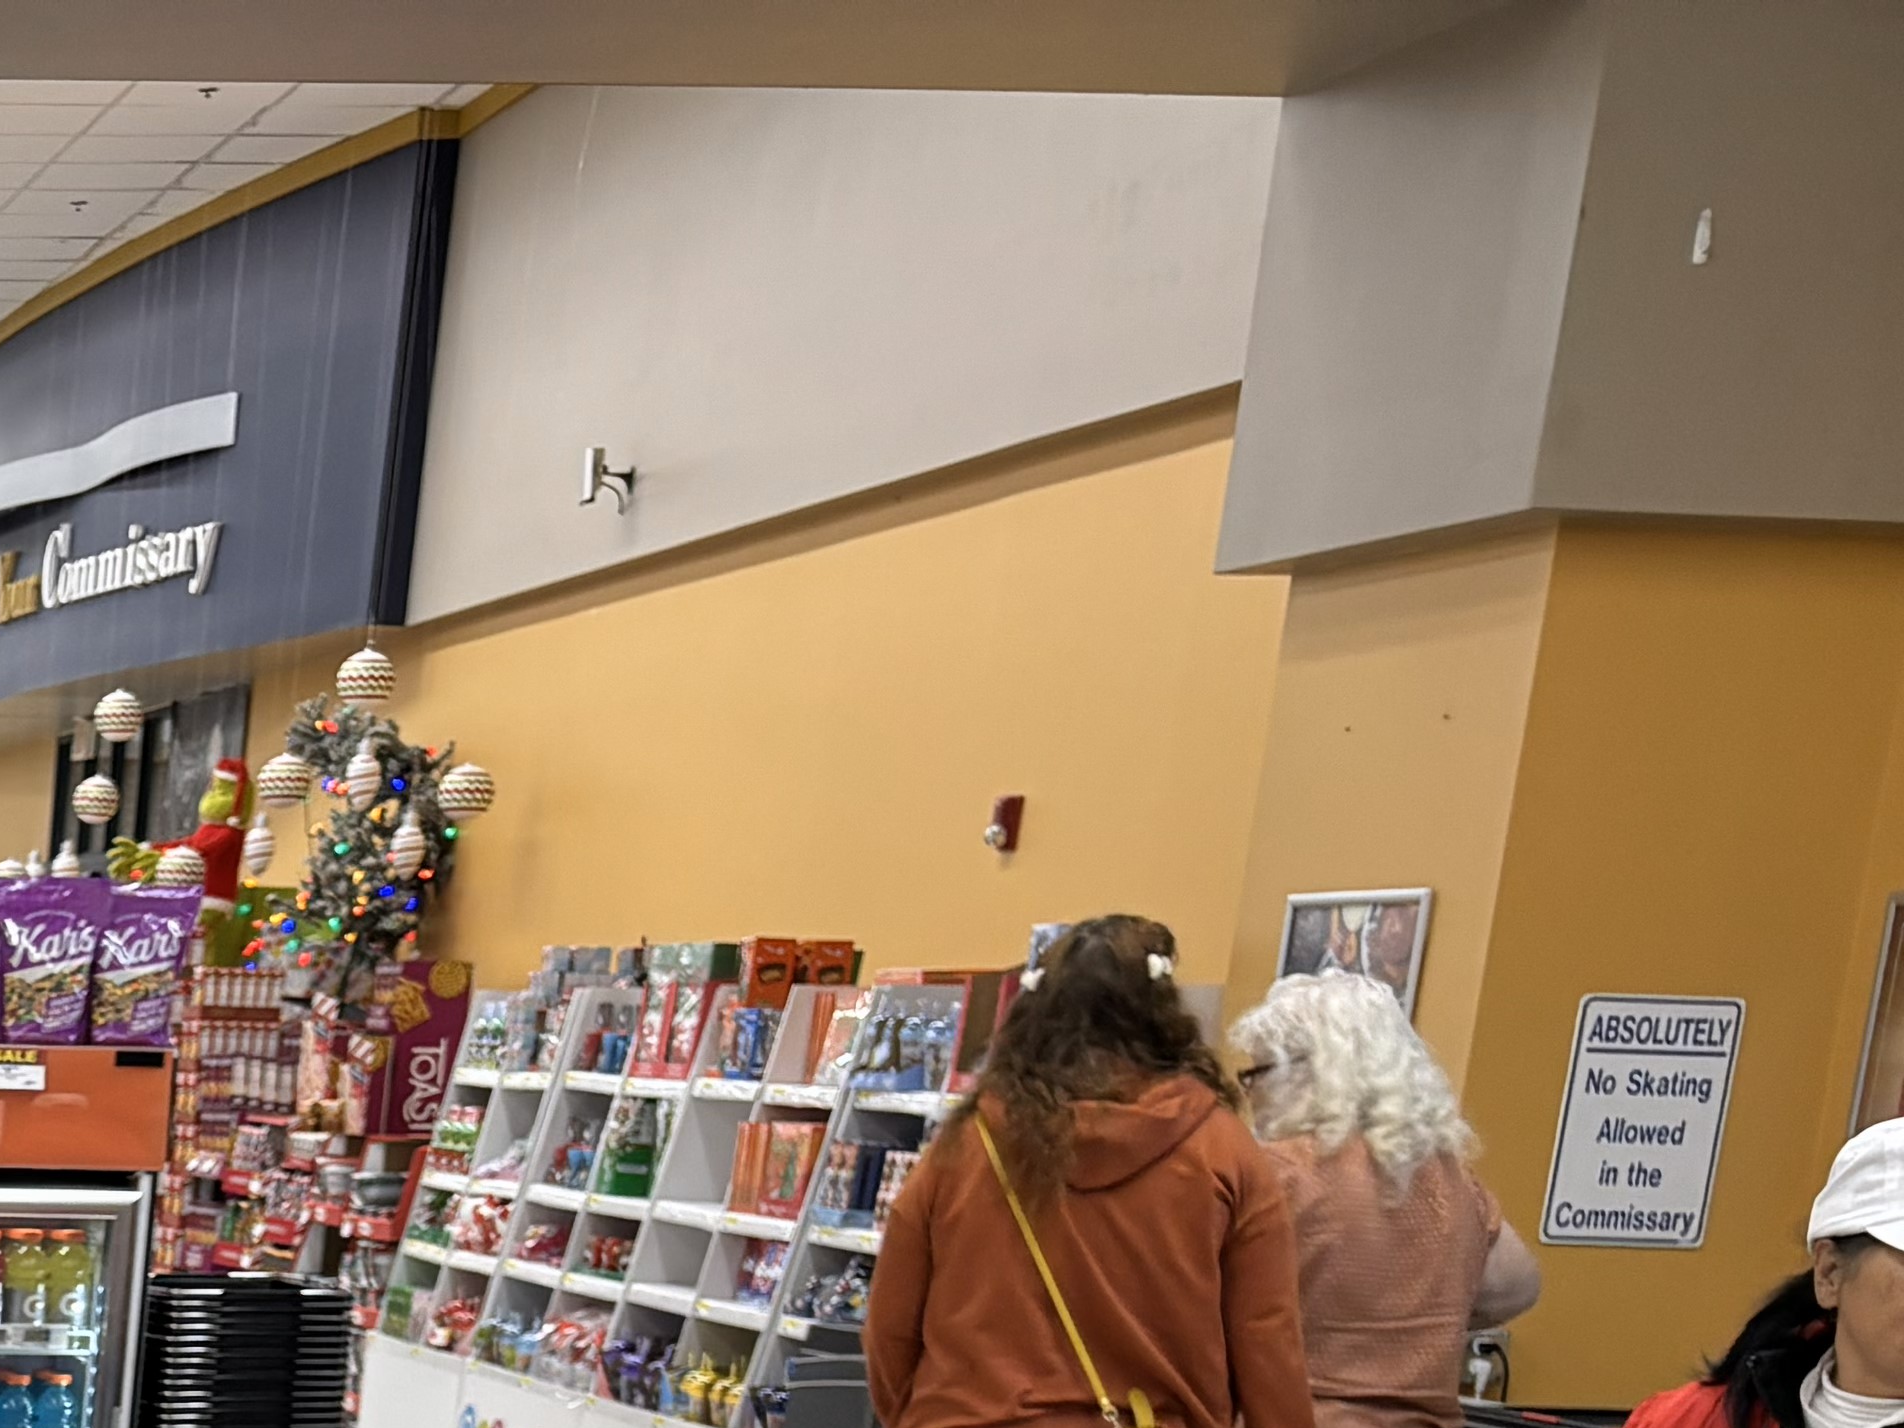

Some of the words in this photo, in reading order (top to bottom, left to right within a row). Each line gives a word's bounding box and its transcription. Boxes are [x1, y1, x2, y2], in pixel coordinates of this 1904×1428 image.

[42, 522, 224, 610] Commissary
[1587, 1014, 1732, 1047] ABSOLUTELY
[1585, 1068, 1616, 1096] No
[1626, 1069, 1713, 1103] Skating
[1596, 1117, 1686, 1146] Allowed
[1598, 1160, 1618, 1187] in
[1627, 1161, 1662, 1187] the
[1555, 1202, 1695, 1237] Commissary
